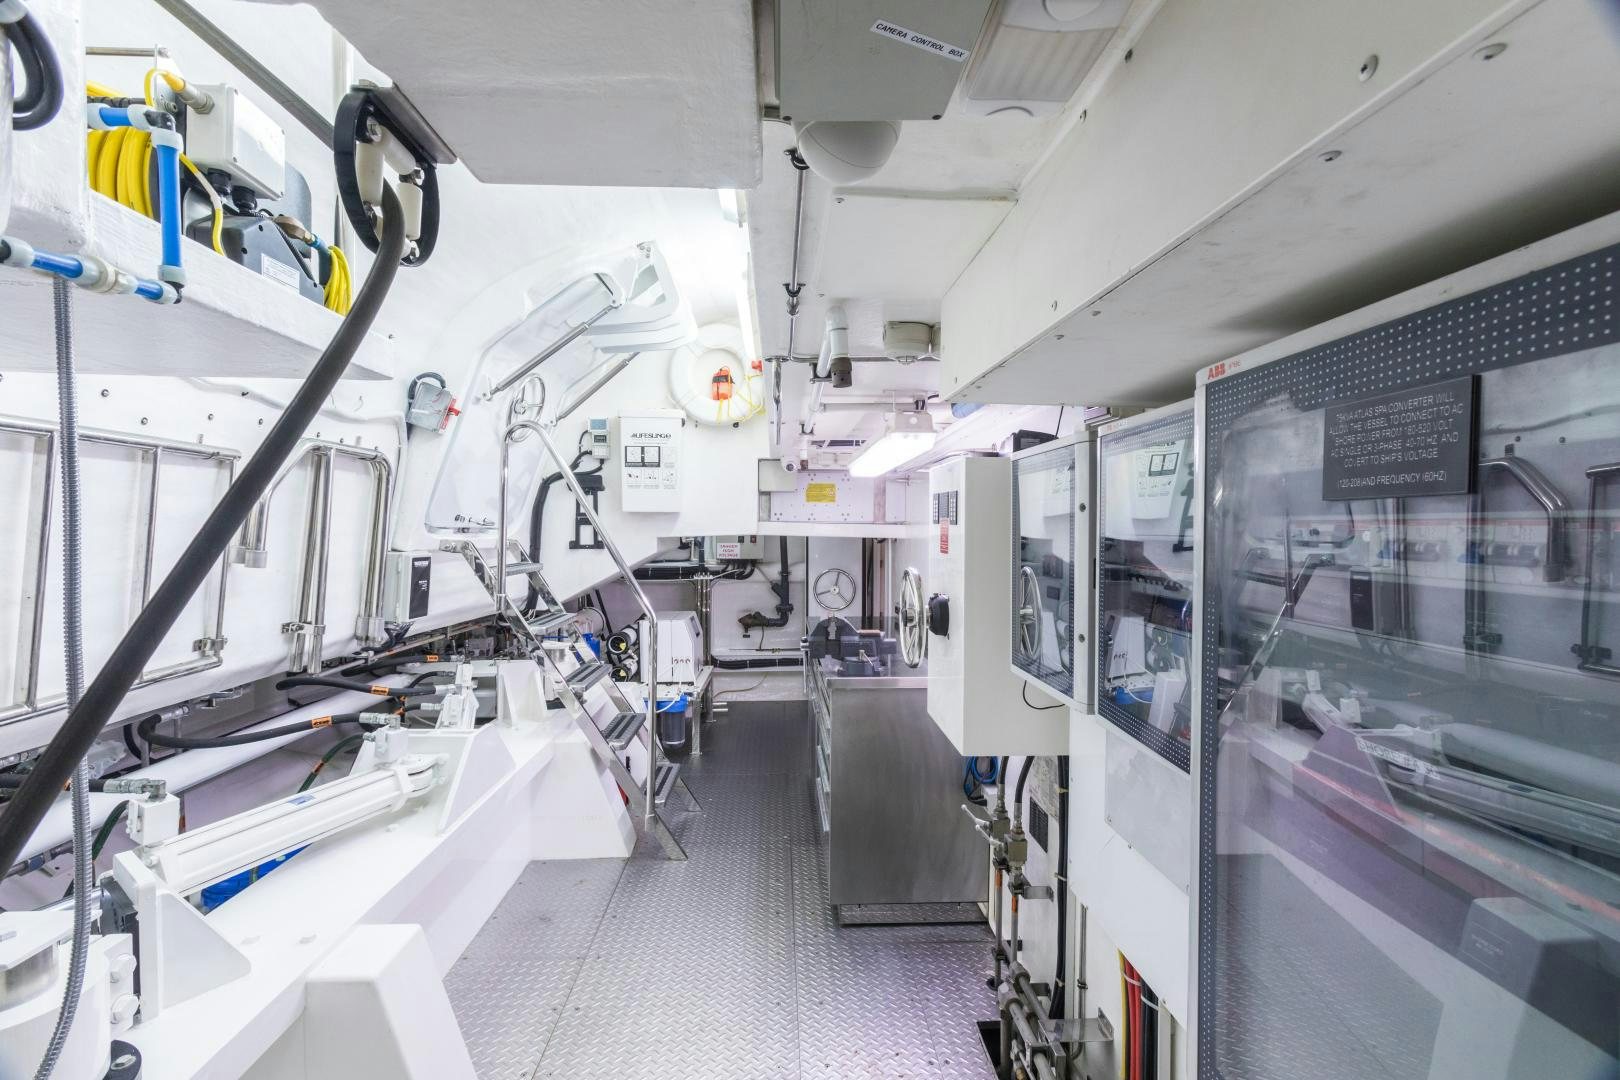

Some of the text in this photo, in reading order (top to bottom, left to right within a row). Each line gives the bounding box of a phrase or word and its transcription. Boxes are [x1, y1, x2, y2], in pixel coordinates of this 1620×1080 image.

[876, 23, 965, 58] CAMERA CONTROL BOX
[1208, 363, 1226, 380] ABB
[1388, 395, 1433, 413] CONVERTER
[1435, 392, 1455, 404] WILL
[1363, 417, 1388, 430] VESSEL
[1390, 415, 1399, 424] TO
[1400, 407, 1438, 424] CONNECT
[1440, 405, 1450, 416] TO
[1451, 403, 1464, 414] AC
[1381, 427, 1402, 439] FROM
[1433, 418, 1454, 431] VOLT
[1441, 431, 1459, 442] AND
[1370, 455, 1380, 465] TO
[1404, 447, 1439, 461] VOLTAGE
[1376, 472, 1420, 486] FREQUENCY
[1421, 469, 1447, 482] (60HZ)
